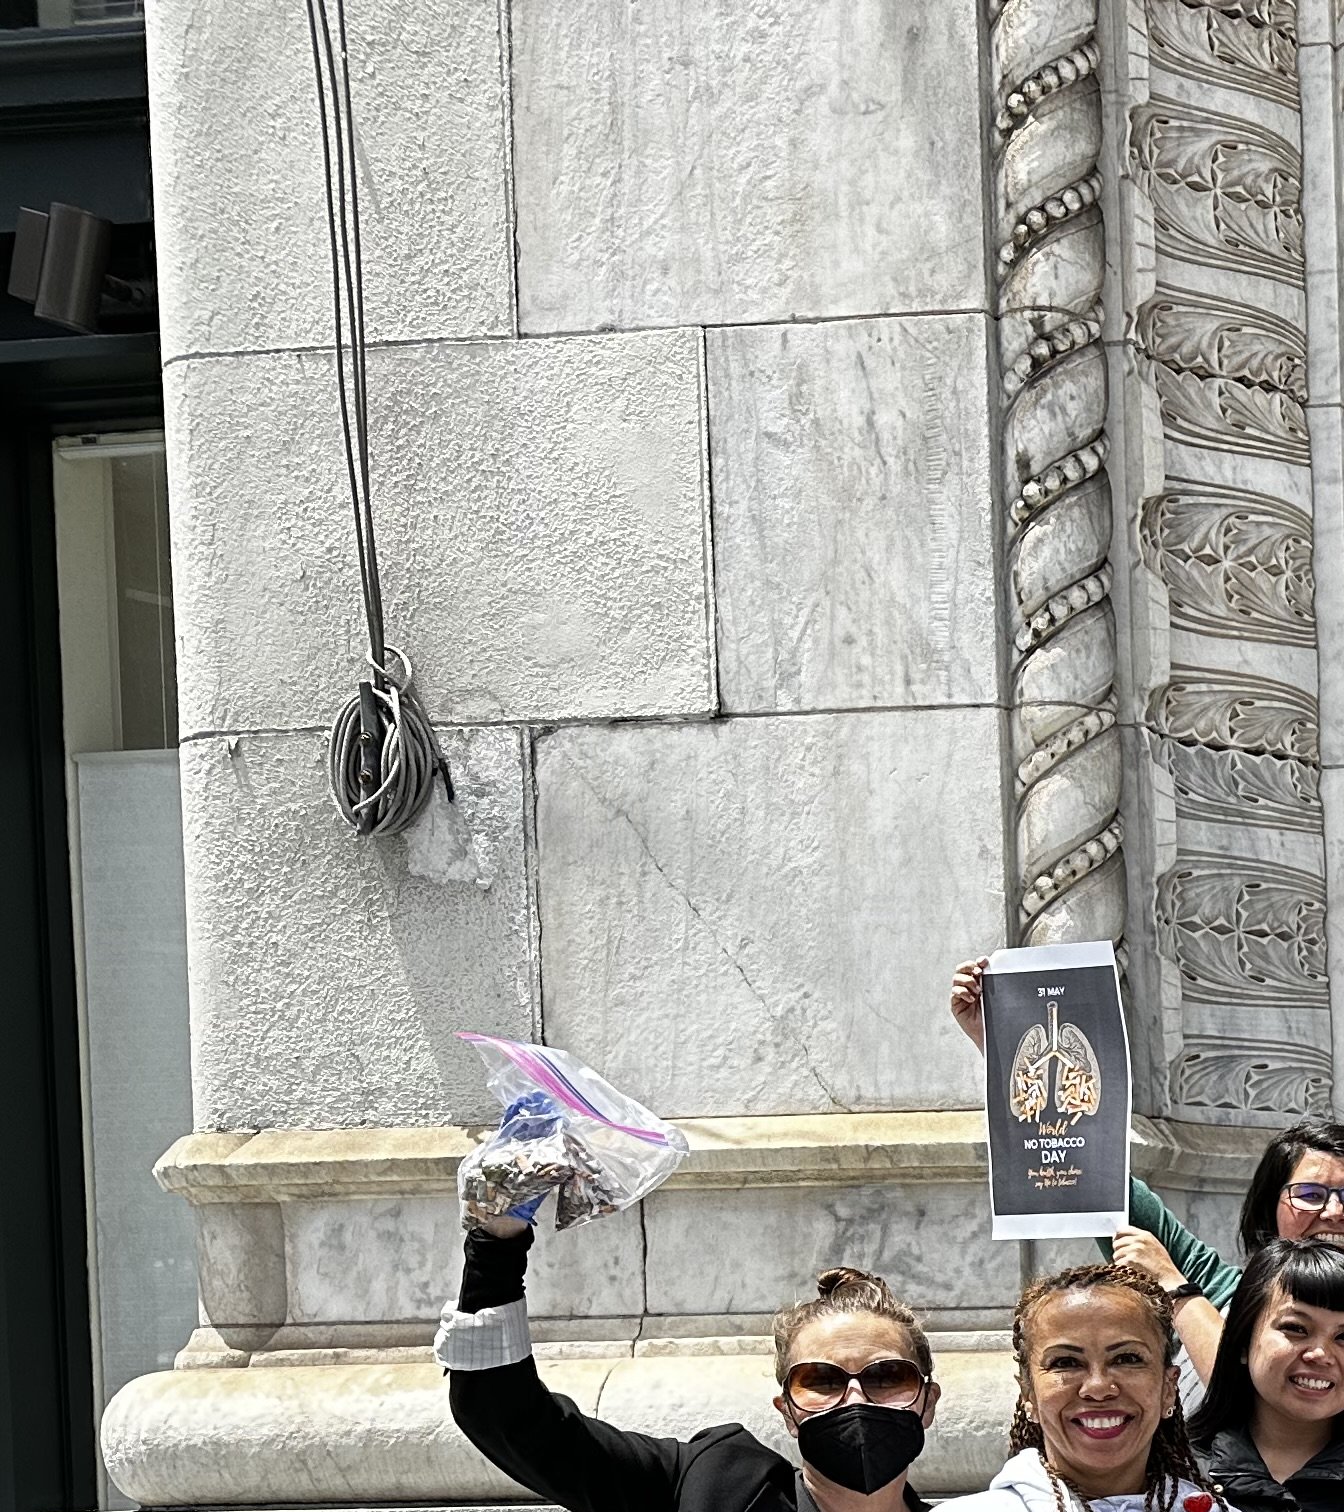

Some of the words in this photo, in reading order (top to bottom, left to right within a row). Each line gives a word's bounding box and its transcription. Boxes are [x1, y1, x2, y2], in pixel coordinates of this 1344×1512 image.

[1046, 986, 1065, 996] MAY
[1038, 1118, 1068, 1136] World
[1024, 1138, 1038, 1150] NO
[1039, 1136, 1085, 1149] TOBACCO
[1041, 1149, 1067, 1164] DAY
